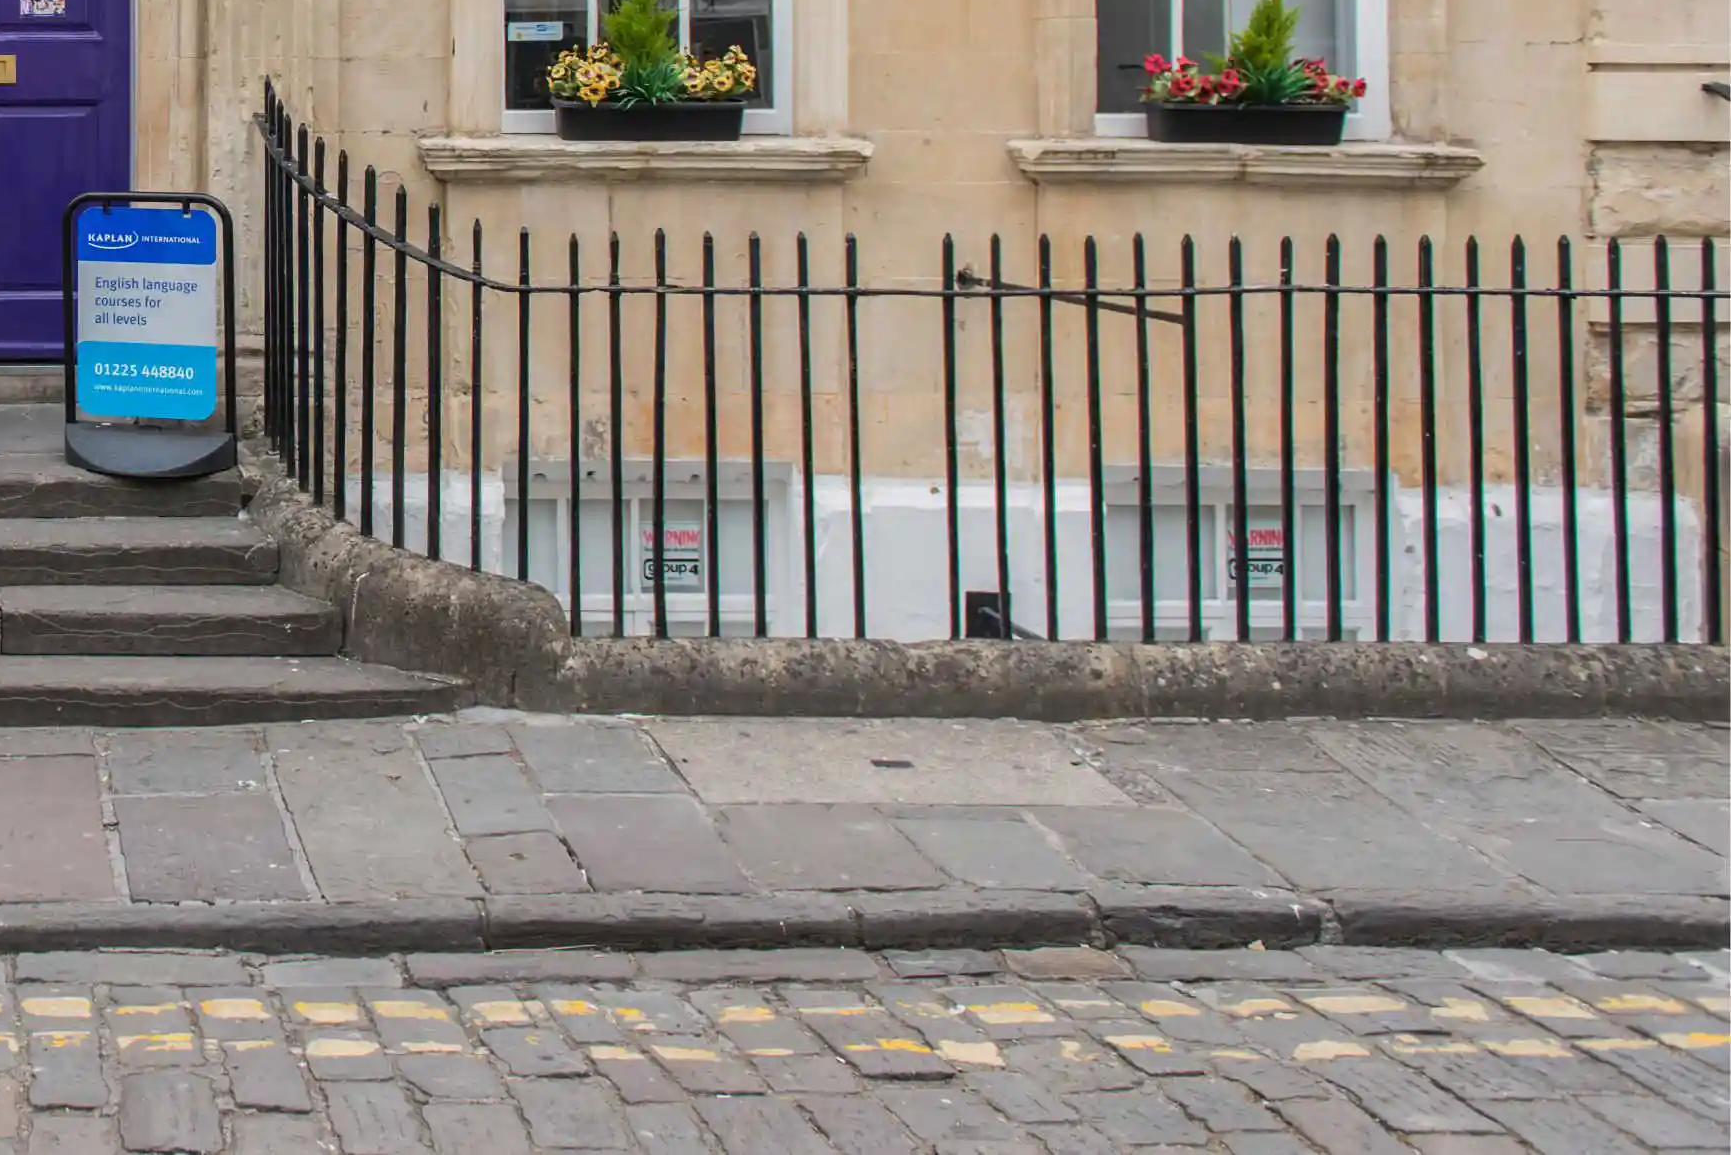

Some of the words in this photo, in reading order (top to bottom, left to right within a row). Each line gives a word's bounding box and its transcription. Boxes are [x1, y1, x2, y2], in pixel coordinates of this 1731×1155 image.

[88, 232, 133, 243] KAPLAN
[141, 235, 201, 244] INTERNATIONAL
[95, 276, 139, 292] English
[142, 277, 198, 294] language
[95, 296, 142, 307] courses
[144, 295, 162, 309] for
[94, 312, 109, 325] all
[112, 312, 148, 326] levels
[94, 362, 138, 377] 01225
[141, 365, 194, 380] 448840
[643, 530, 700, 546] WRNING
[647, 563, 687, 576] goup
